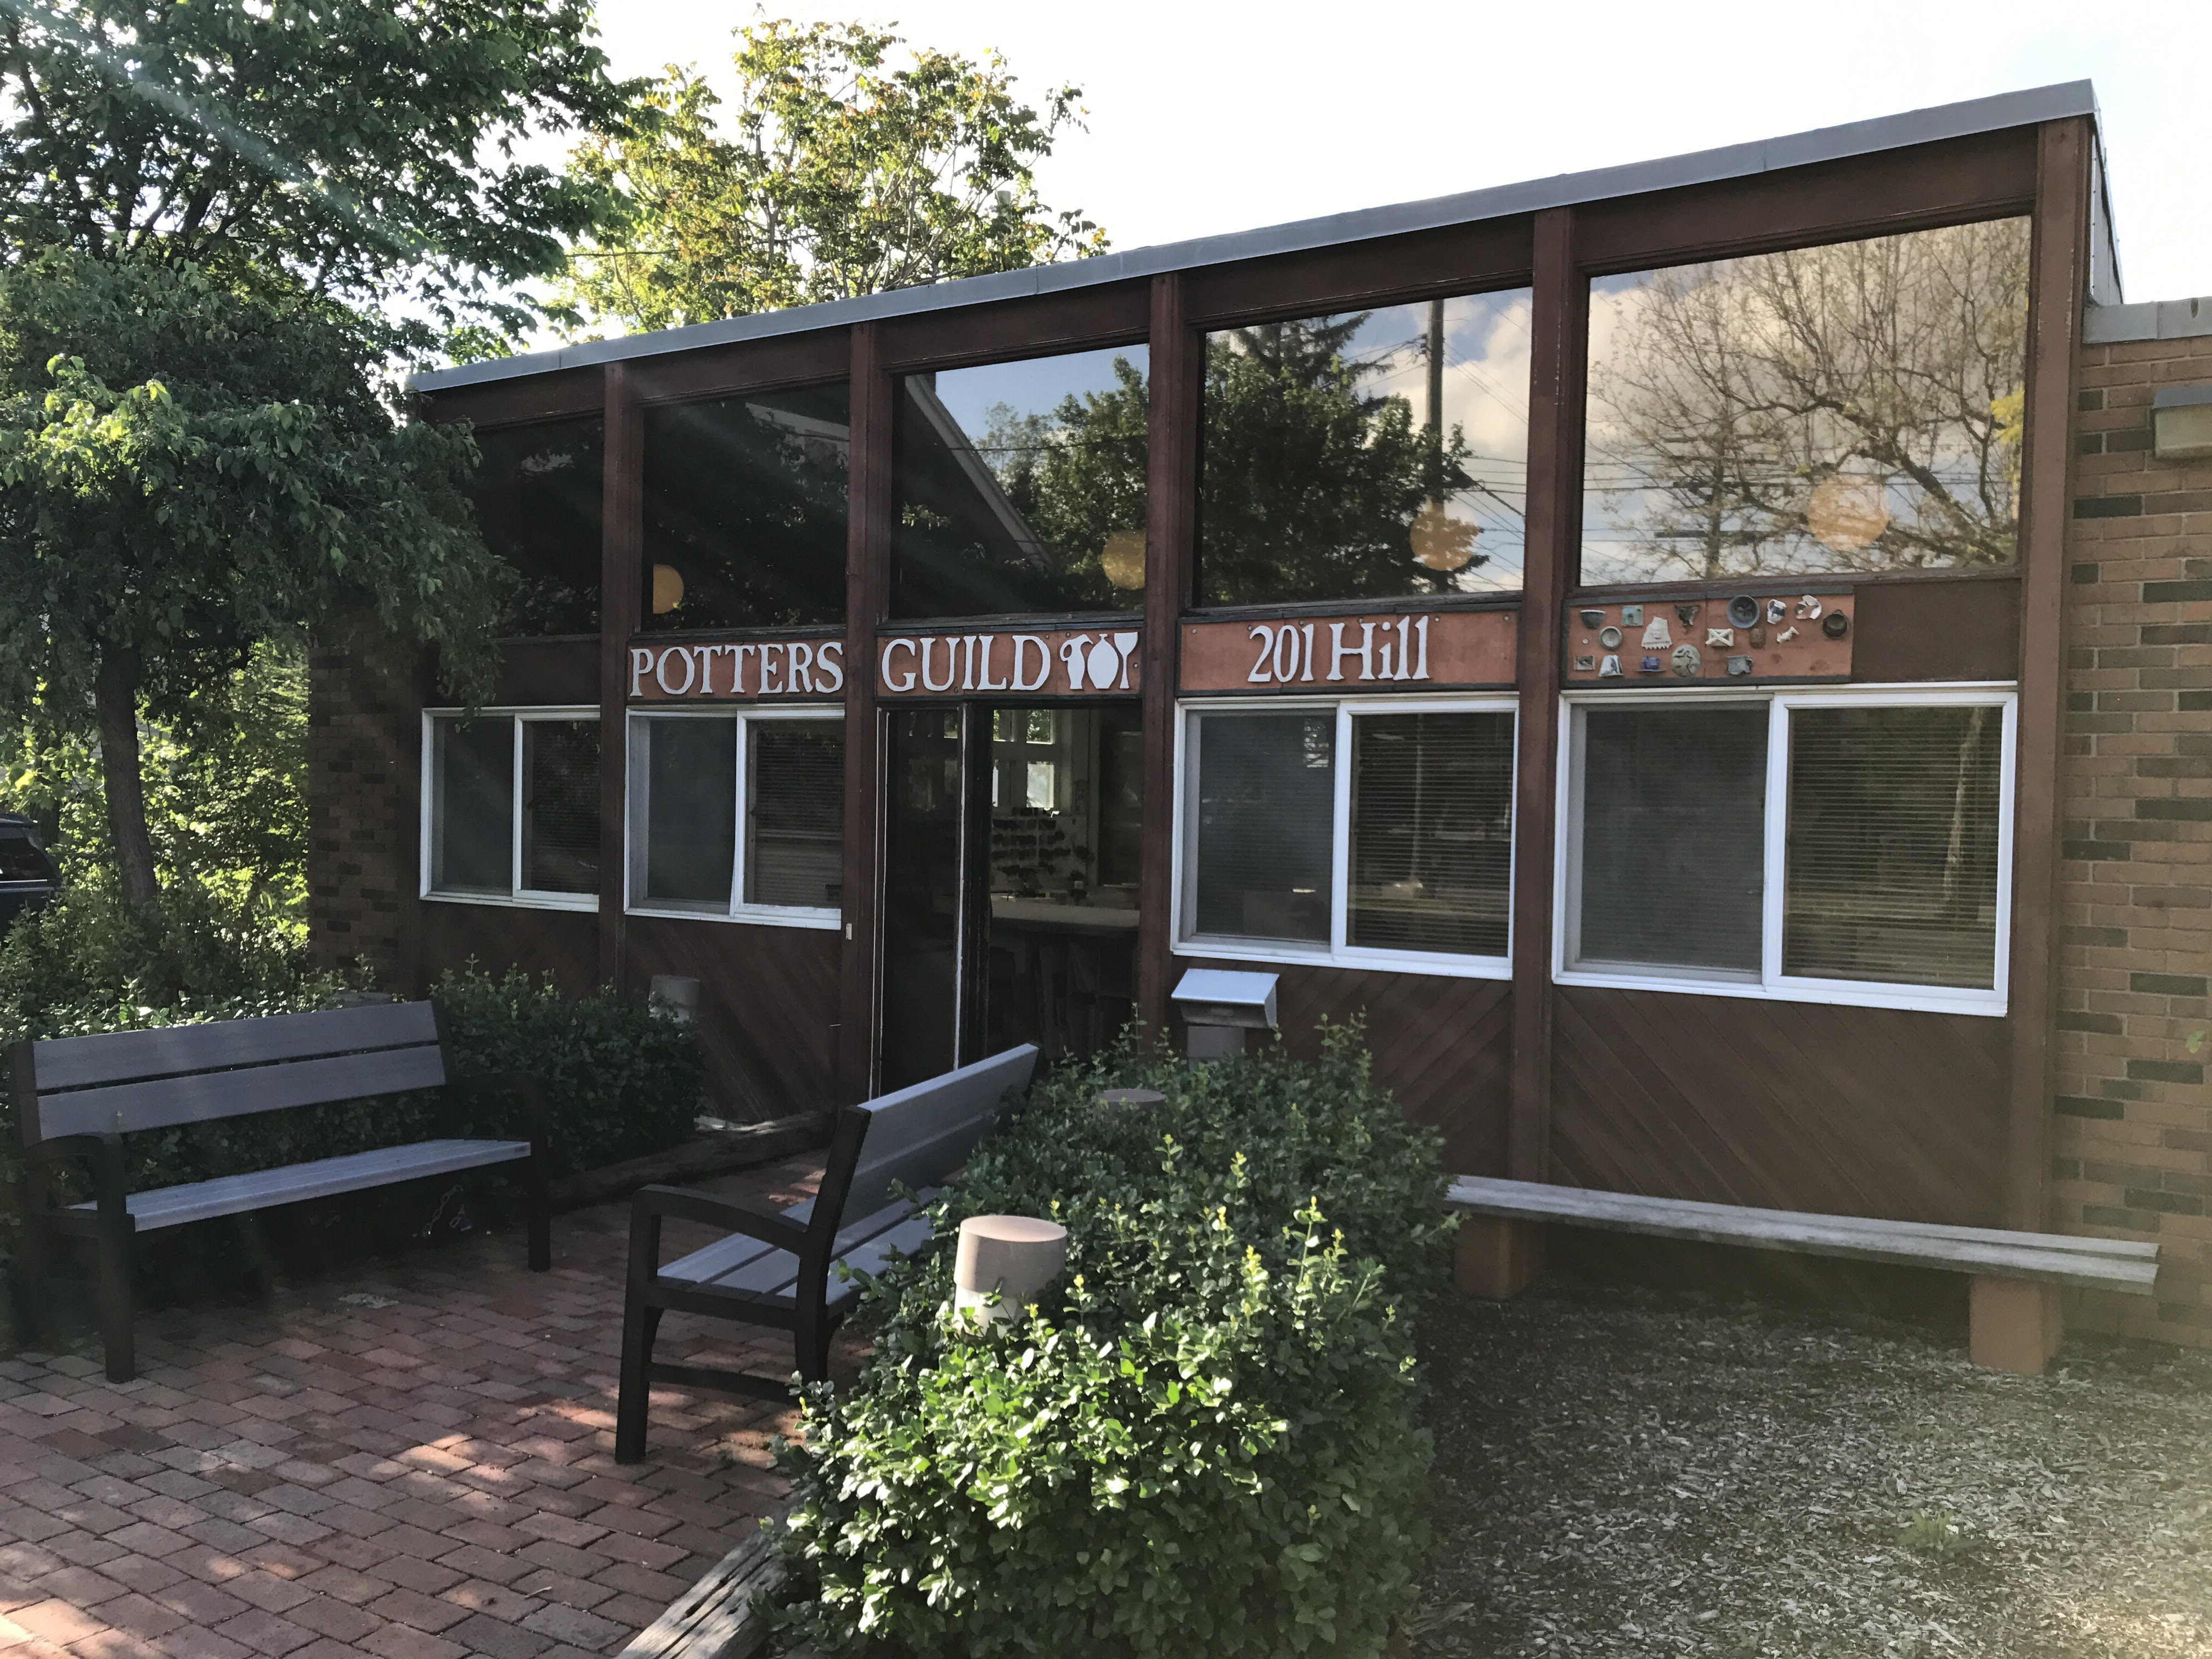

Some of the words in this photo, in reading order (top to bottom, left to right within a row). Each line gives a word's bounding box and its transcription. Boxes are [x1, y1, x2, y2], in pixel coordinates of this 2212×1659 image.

[630, 642, 844, 697] POTTERS
[881, 635, 1051, 691] GUILD
[1248, 624, 1314, 682] 201
[1327, 616, 1430, 681] Hill
